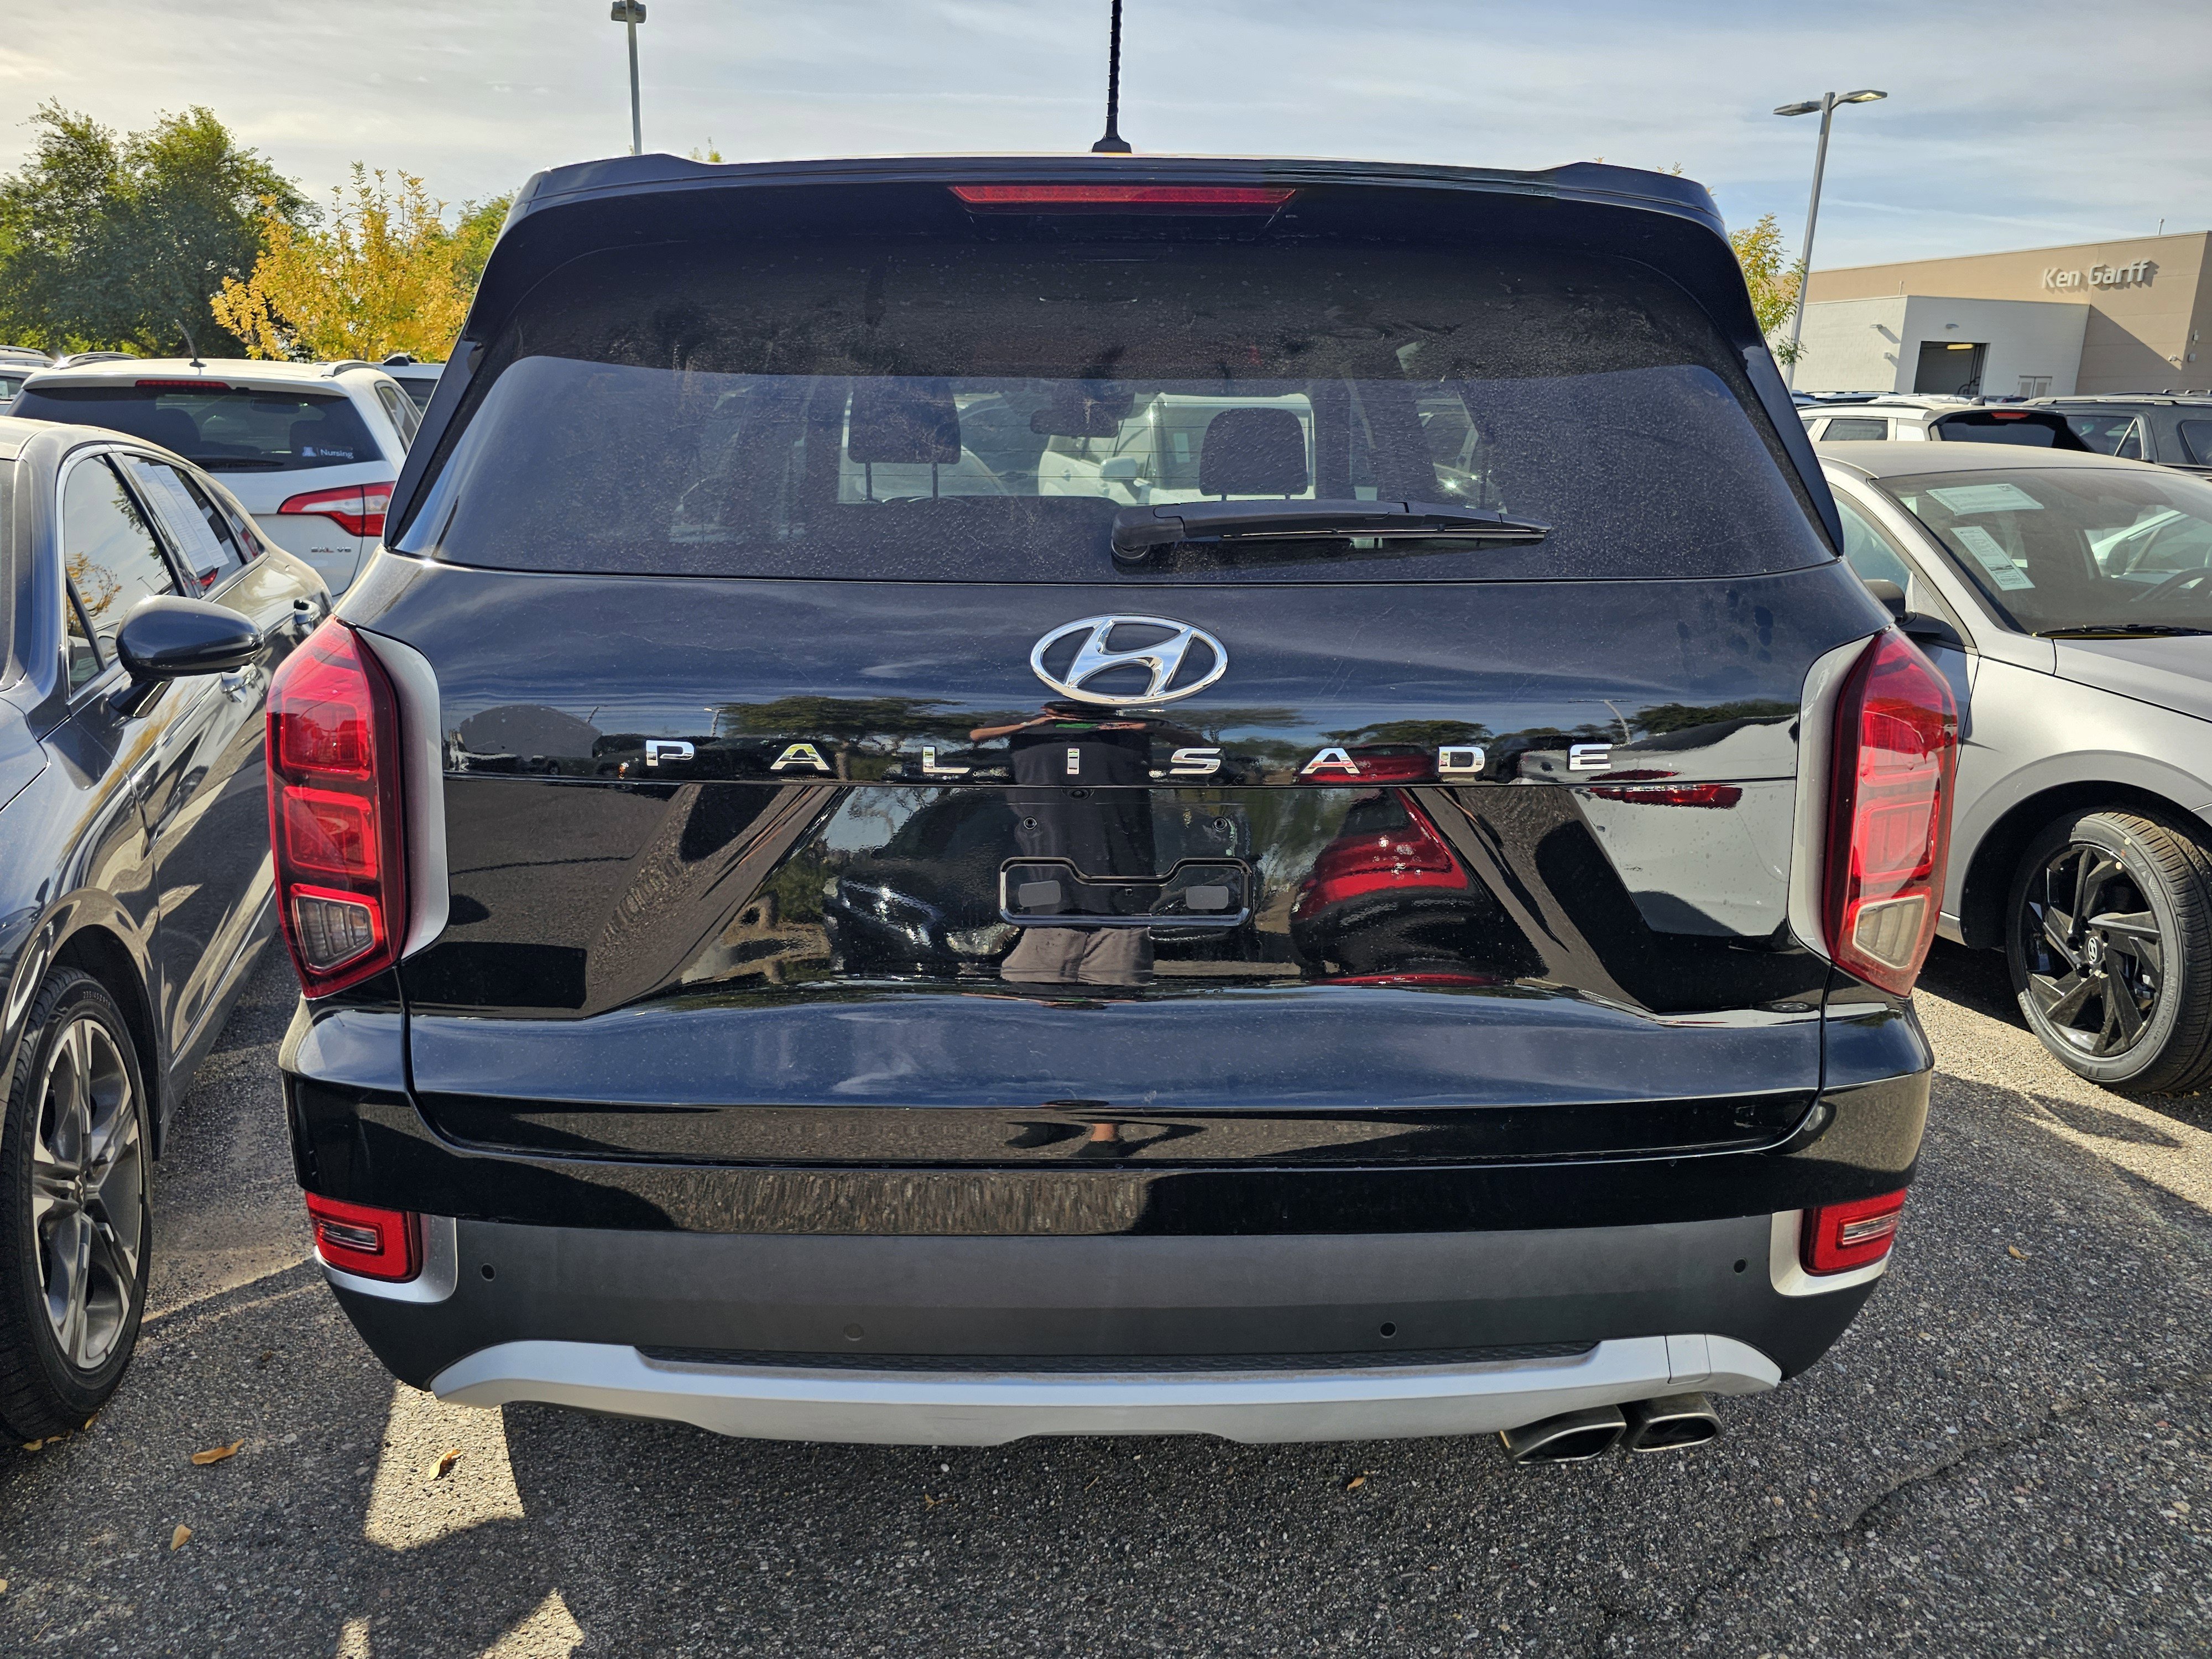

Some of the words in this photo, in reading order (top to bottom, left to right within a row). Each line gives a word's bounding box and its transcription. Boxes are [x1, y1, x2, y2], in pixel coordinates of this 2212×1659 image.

[2042, 267, 2081, 289] Ken
[2088, 259, 2151, 285] Garff
[320, 448, 354, 460] Nursing
[646, 740, 1613, 774] PALISADE
